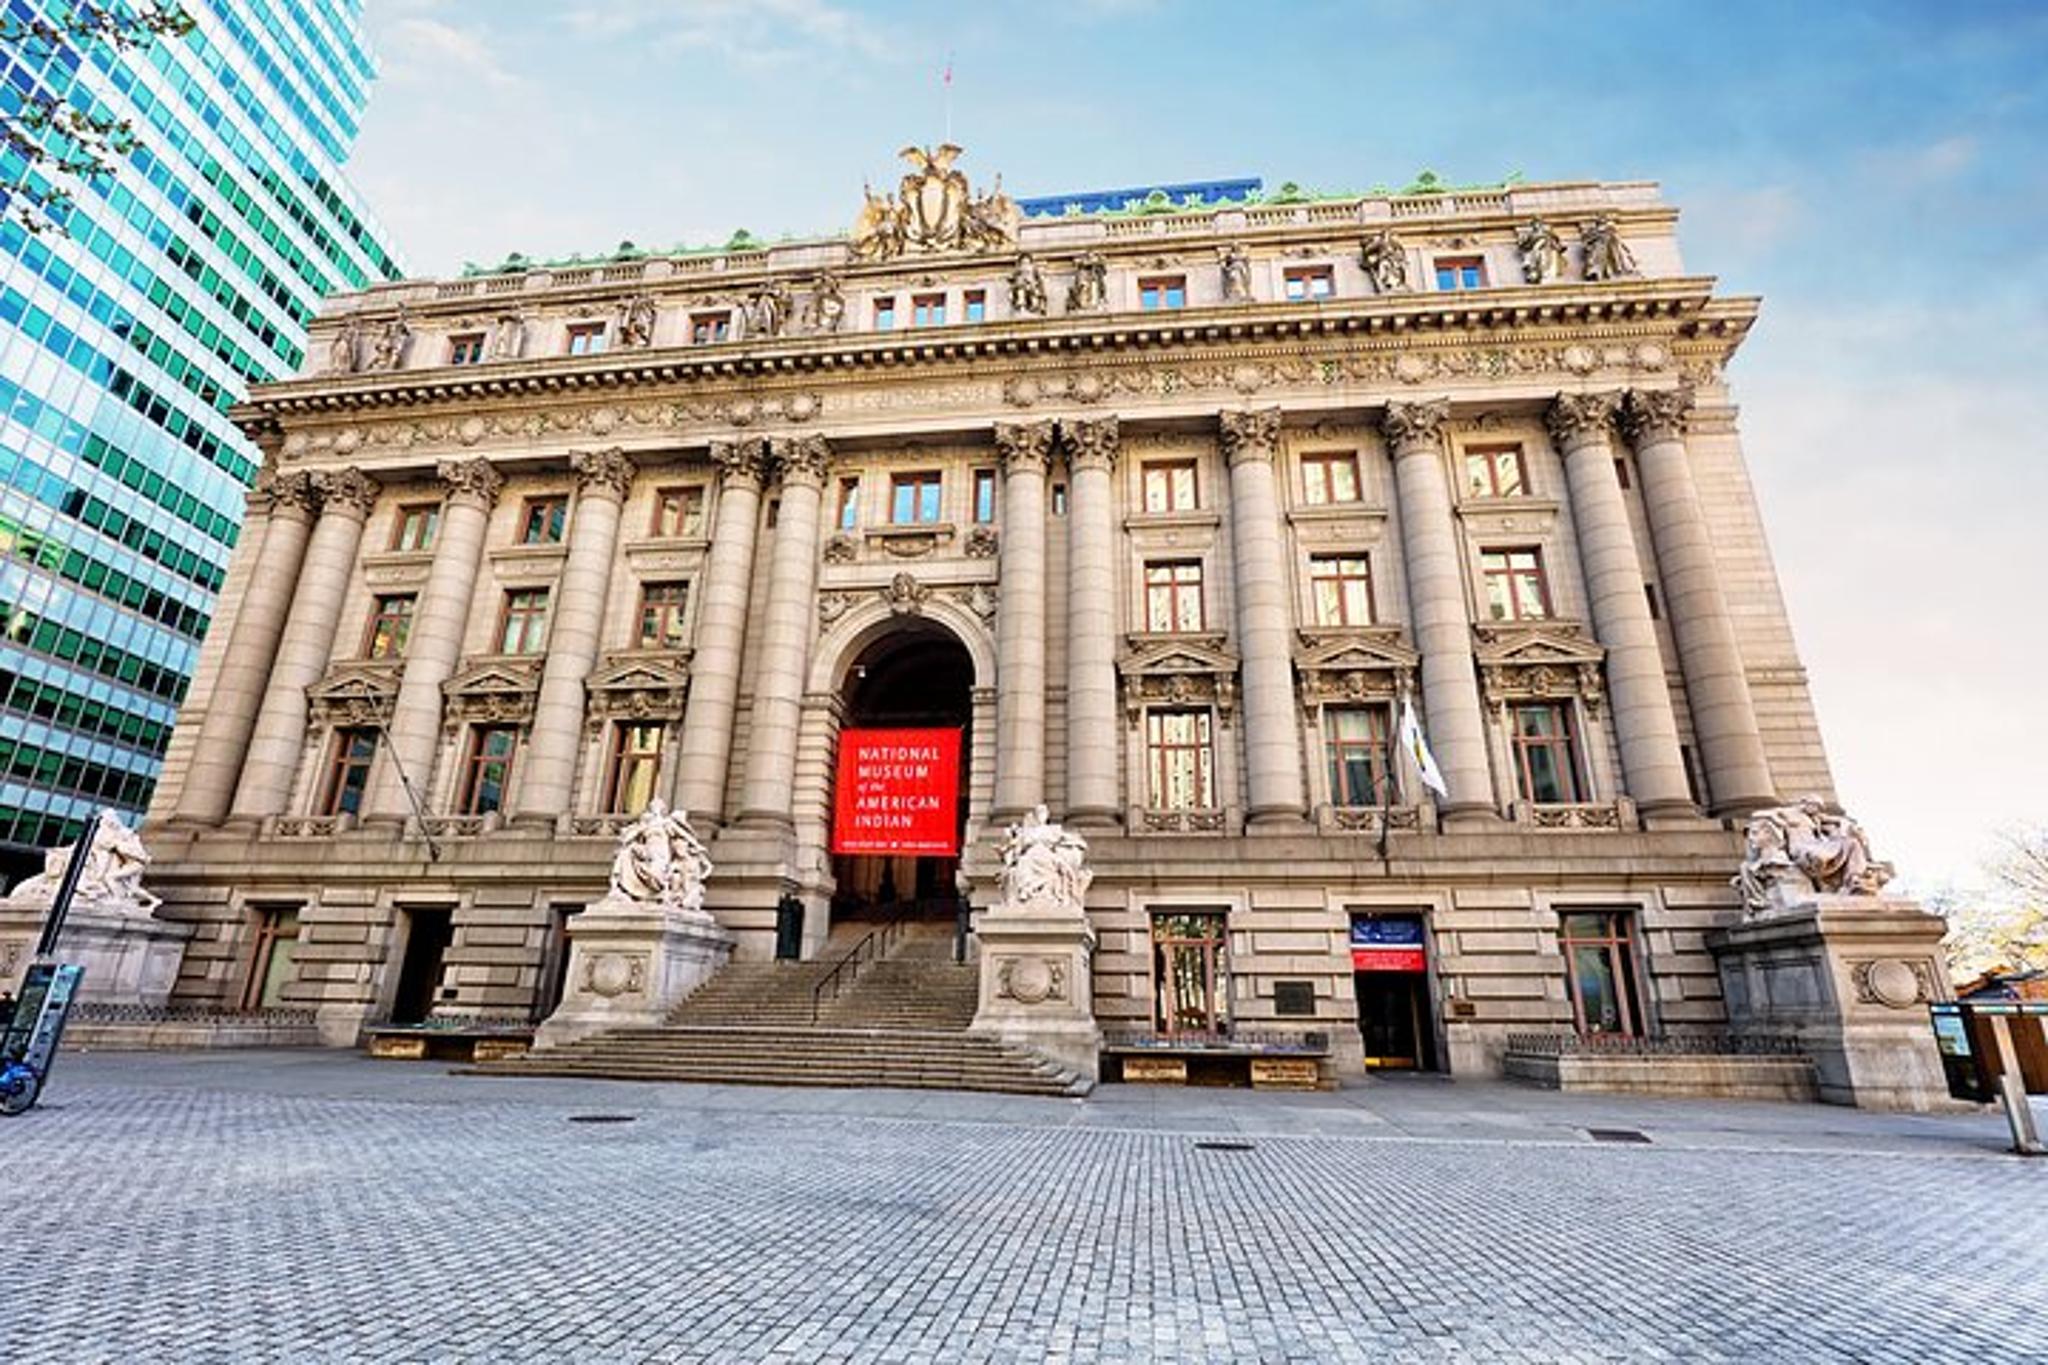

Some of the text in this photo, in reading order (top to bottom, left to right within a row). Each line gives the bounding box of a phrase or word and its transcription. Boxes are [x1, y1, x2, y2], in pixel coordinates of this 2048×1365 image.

[858, 747, 939, 760] NATIONAL
[858, 764, 928, 779] MUSEUM
[856, 796, 939, 810] AMERICAN
[855, 815, 911, 828] INDIAN
